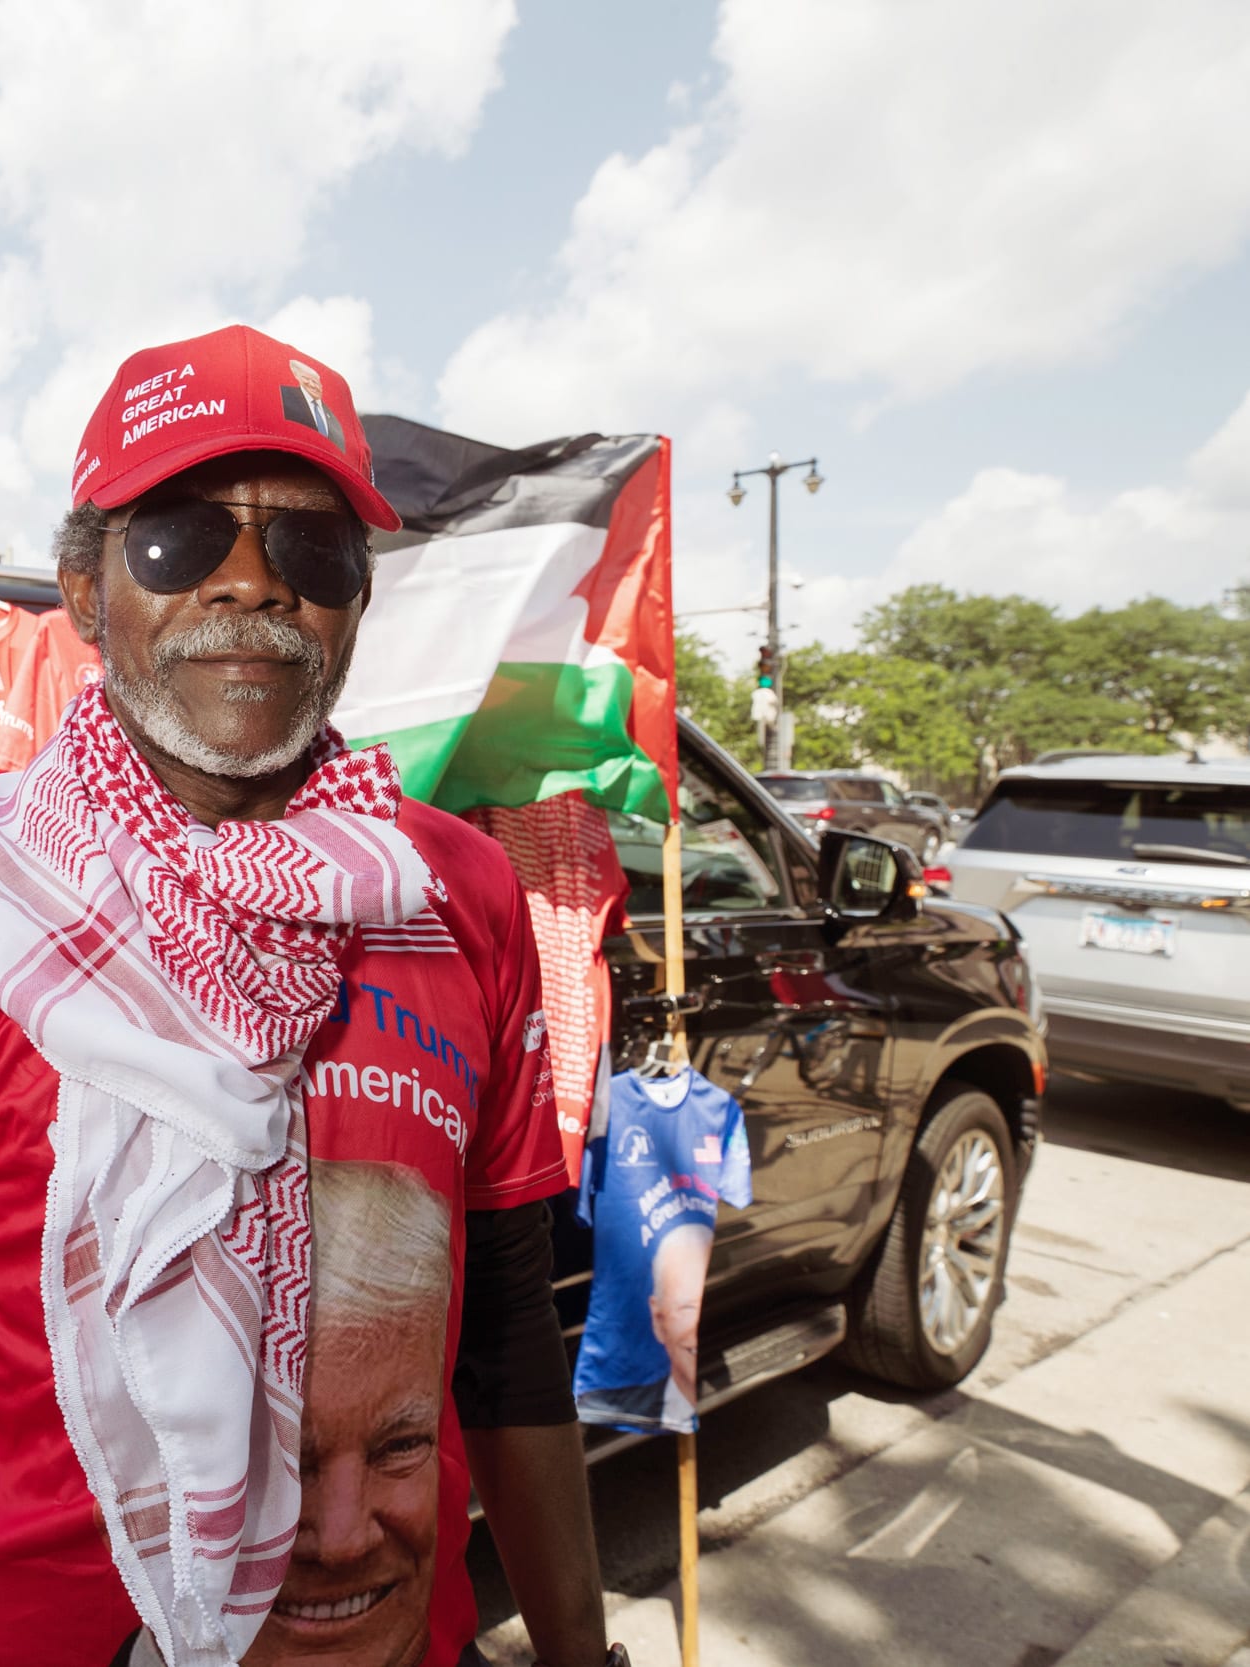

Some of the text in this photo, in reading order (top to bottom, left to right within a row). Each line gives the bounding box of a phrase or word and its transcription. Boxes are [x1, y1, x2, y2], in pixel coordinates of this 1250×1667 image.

[124, 363, 195, 402] MEET A
[121, 385, 187, 423] GREAT
[121, 399, 226, 450] AMERICAN
